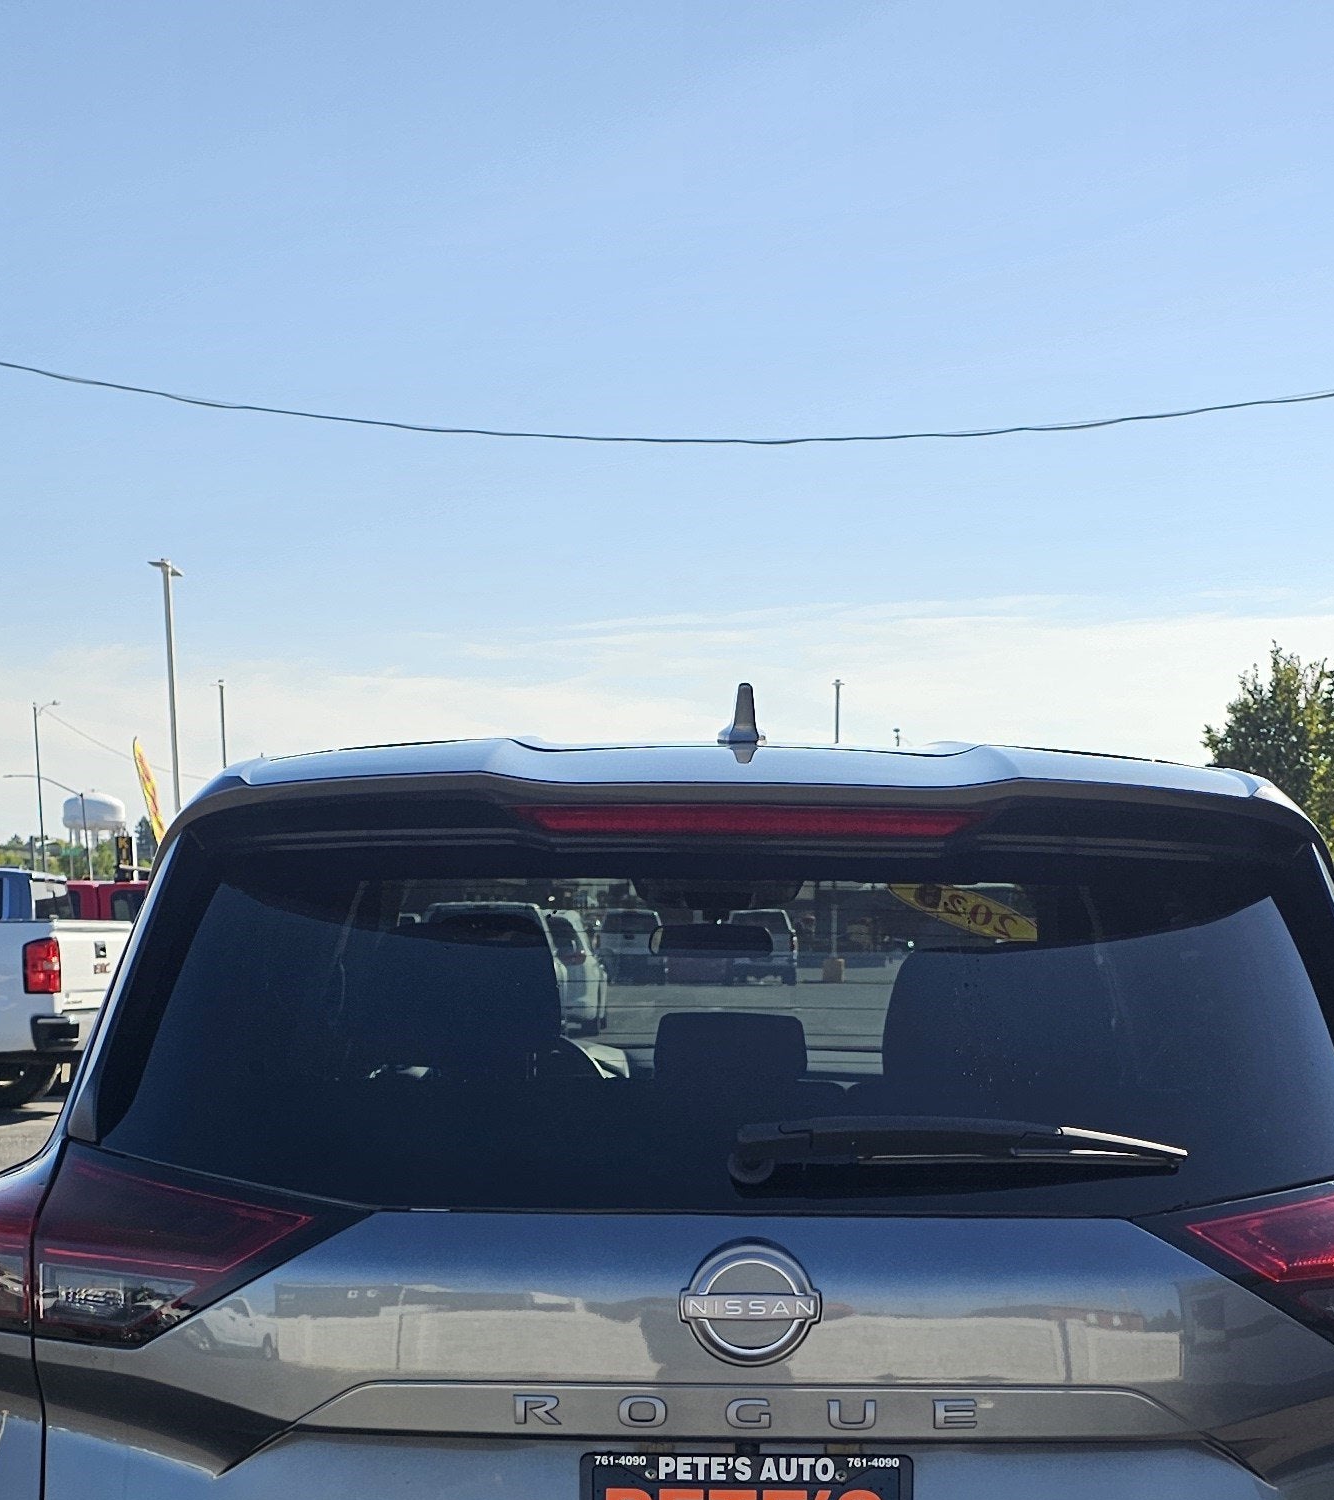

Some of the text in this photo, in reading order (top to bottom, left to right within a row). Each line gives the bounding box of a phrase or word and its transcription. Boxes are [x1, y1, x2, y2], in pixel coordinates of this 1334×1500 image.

[688, 1299, 816, 1316] NISSAN
[512, 1394, 979, 1431] ROGUE
[594, 1455, 647, 1466] 761-4090
[658, 1456, 835, 1482] PETE'S AUTO
[846, 1457, 900, 1468] 761-4090
